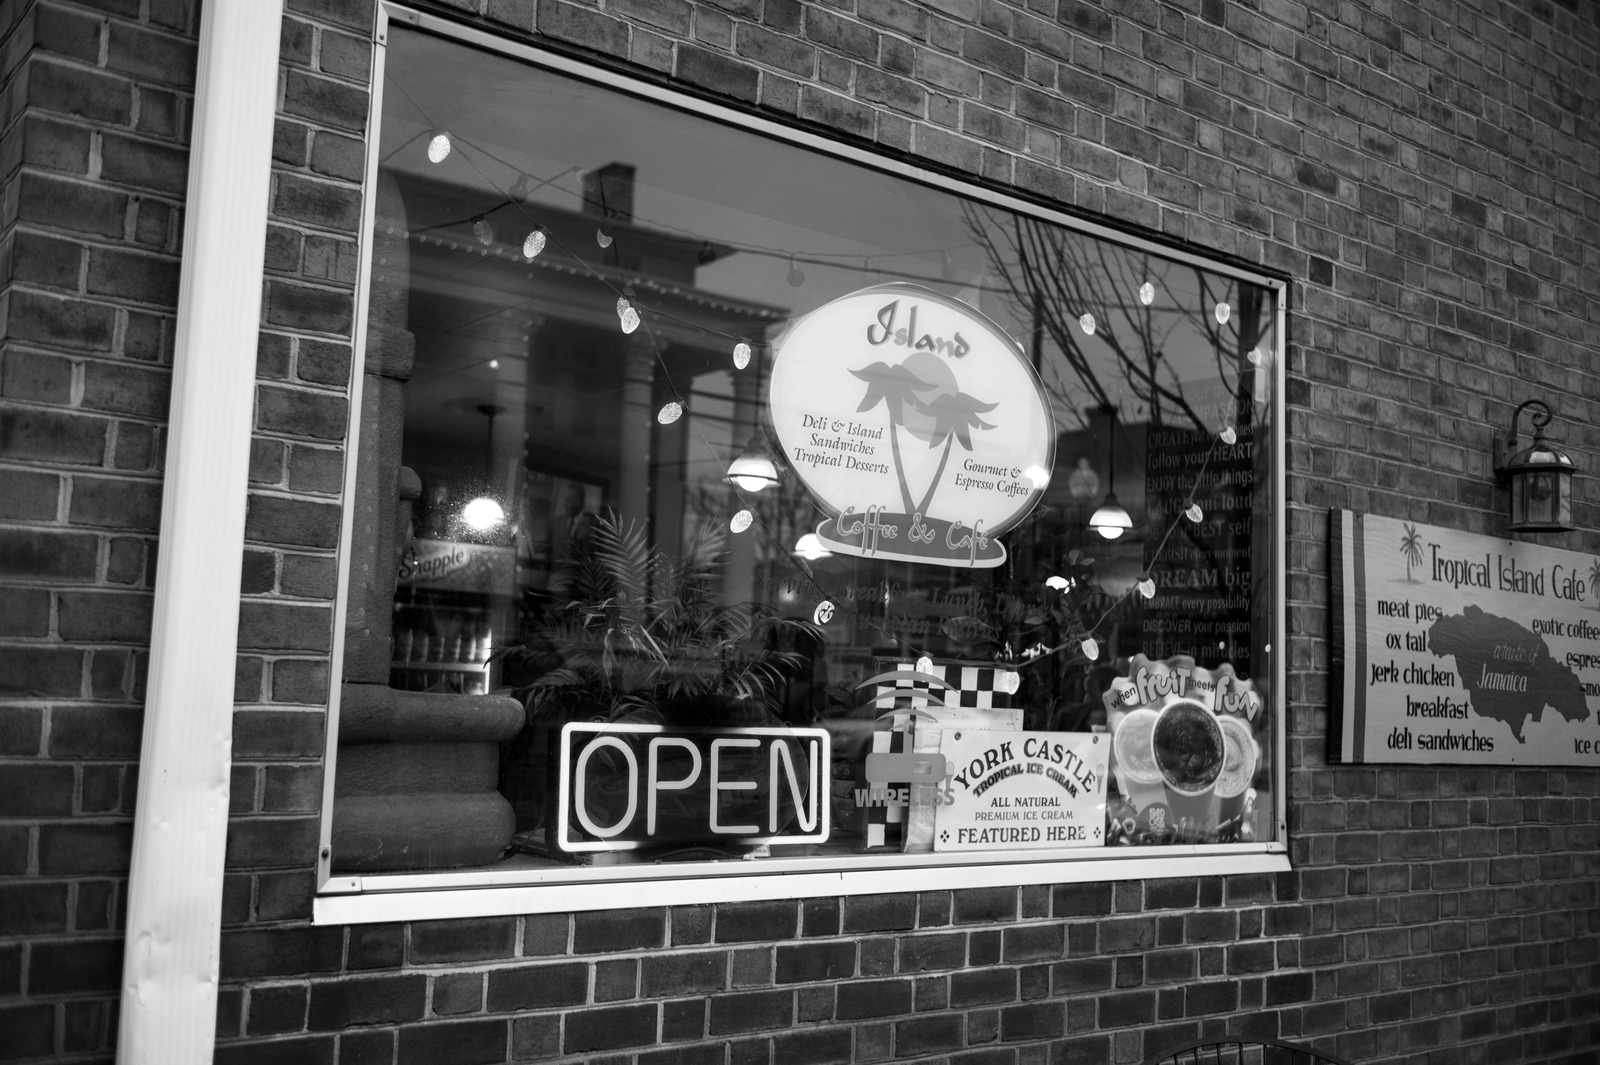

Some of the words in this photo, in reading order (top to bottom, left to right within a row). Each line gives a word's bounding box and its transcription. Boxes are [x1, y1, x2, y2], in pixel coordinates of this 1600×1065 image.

[866, 299, 971, 359] Island
[801, 413, 828, 432] Deli
[830, 420, 846, 433] &
[847, 422, 884, 440] Island
[1148, 429, 1189, 449] CREATE
[809, 432, 875, 456] Sandwiches
[1147, 451, 1181, 470] follow
[1184, 450, 1211, 469] your
[1213, 441, 1254, 462] HEART
[793, 446, 842, 470] Tropical
[845, 456, 890, 475] Desserts
[963, 458, 1008, 478] Gourmet
[1009, 467, 1023, 479] &
[954, 473, 995, 492] Espresso
[996, 480, 1030, 498] Coffees
[1146, 473, 1176, 493] ENJOY
[1178, 472, 1194, 490] the
[1221, 468, 1254, 487] things
[1221, 491, 1253, 510] loud
[836, 504, 899, 556] Coffee
[907, 512, 936, 545] &
[1193, 519, 1226, 538] BEST
[1228, 515, 1253, 536] self
[1224, 566, 1251, 596] big
[1428, 542, 1492, 590] Tropical
[1498, 554, 1545, 597] Island
[1551, 563, 1586, 602] Cafe
[1182, 597, 1205, 613] every
[1207, 594, 1250, 612] possibility
[1377, 598, 1411, 619] meat
[1415, 602, 1443, 624] pies
[1143, 619, 1192, 633] DISCOVER
[1193, 621, 1213, 636] your
[1215, 619, 1250, 636] passion
[1532, 617, 1565, 637] exotic
[1386, 632, 1402, 650] ox
[1405, 630, 1427, 652] tail
[1403, 661, 1455, 688] chicken
[1476, 663, 1528, 692] Jamaica
[1110, 686, 1137, 709] when
[1190, 678, 1215, 693] meets
[1406, 694, 1469, 719] breakfast
[1387, 726, 1413, 750] deli
[1417, 727, 1494, 752] sandwiches
[1574, 738, 1592, 754] ice
[954, 741, 1015, 790] YORK
[1023, 738, 1096, 793] CASTLE
[575, 736, 818, 838] OPEN
[973, 763, 1024, 798] TROPICAL
[1026, 762, 1044, 775] ICE
[1045, 767, 1079, 800] CREAM
[854, 787, 955, 808] WIRELESS
[990, 797, 1011, 808] ALL
[1014, 796, 1061, 807] NATURAL
[974, 811, 1020, 821] PREMIUM
[1023, 811, 1038, 820] ICE
[1041, 810, 1074, 820] CREAM
[957, 826, 1041, 844] FEATURED
[1046, 825, 1087, 842] HERE
